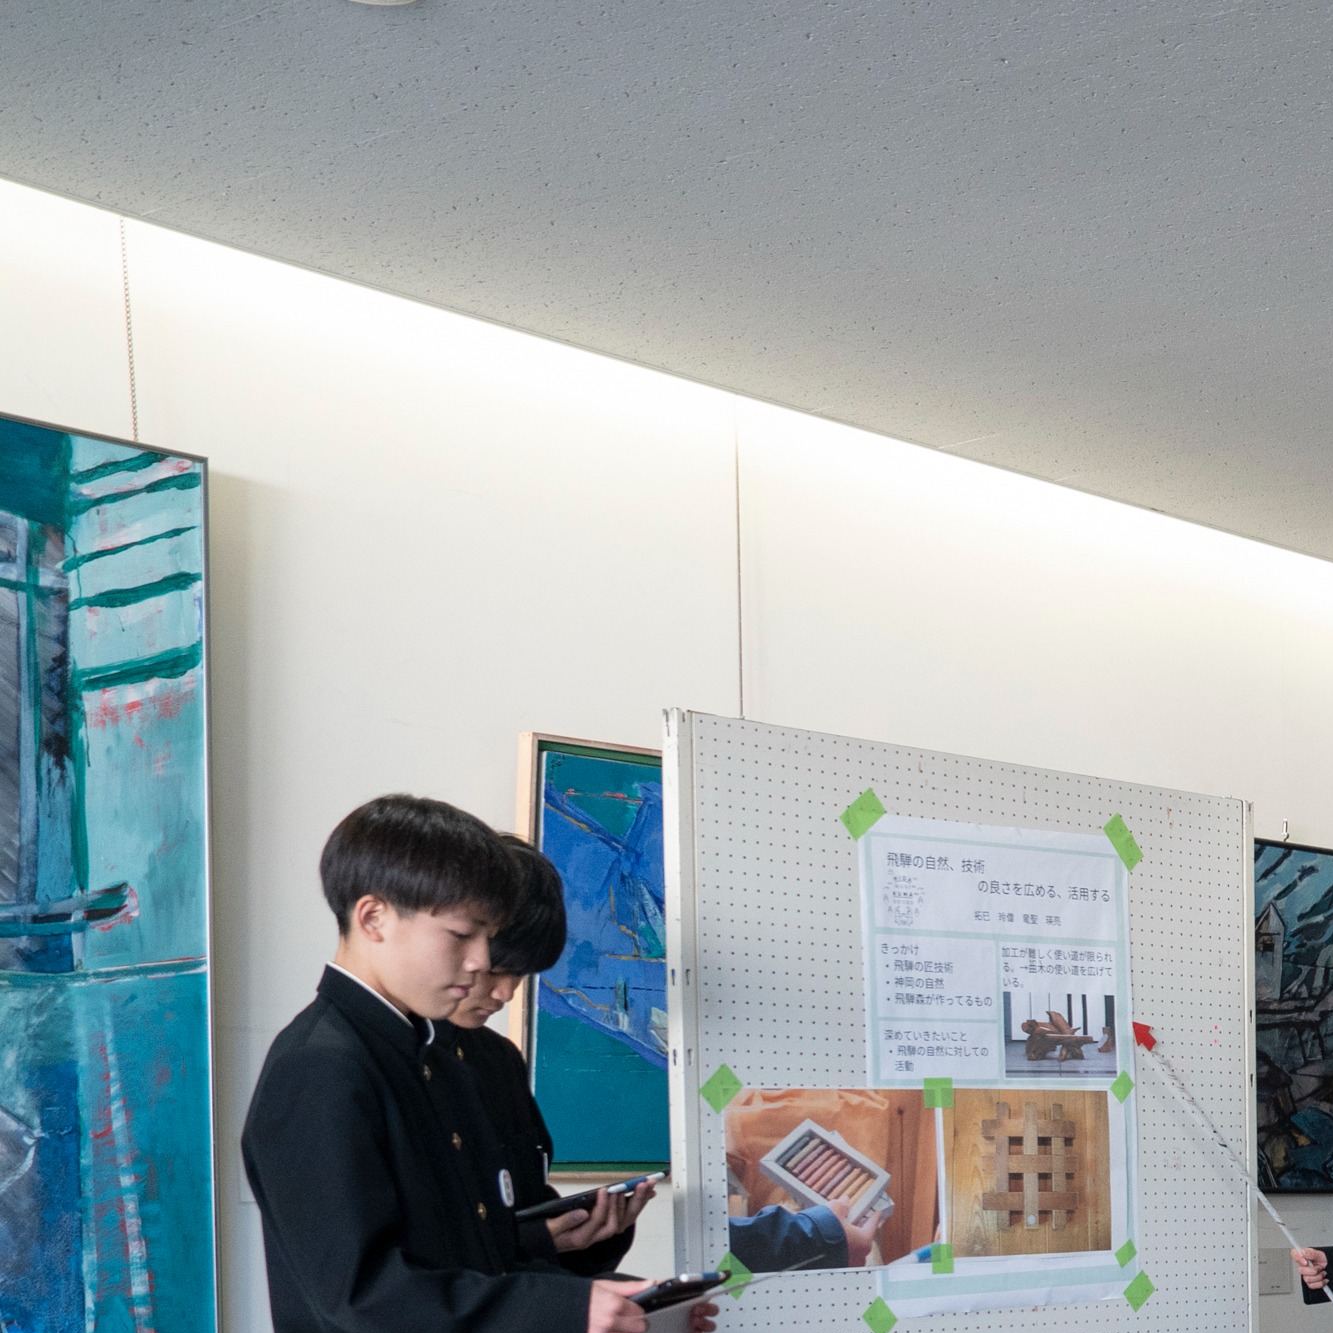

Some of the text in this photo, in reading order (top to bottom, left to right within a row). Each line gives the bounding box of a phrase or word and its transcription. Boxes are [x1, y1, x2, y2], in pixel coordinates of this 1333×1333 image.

[887, 852, 985, 875] 飛騨の自然、技術
[978, 880, 1110, 902] の良さを広める、活用する
[881, 943, 919, 955] きっかけ
[1001, 947, 1113, 963] 加工が難しく使い道が限られ
[1003, 977, 1025, 988] いる。
[884, 1029, 968, 1042] 深めていきたいこと
[895, 1060, 915, 1072] 活動
